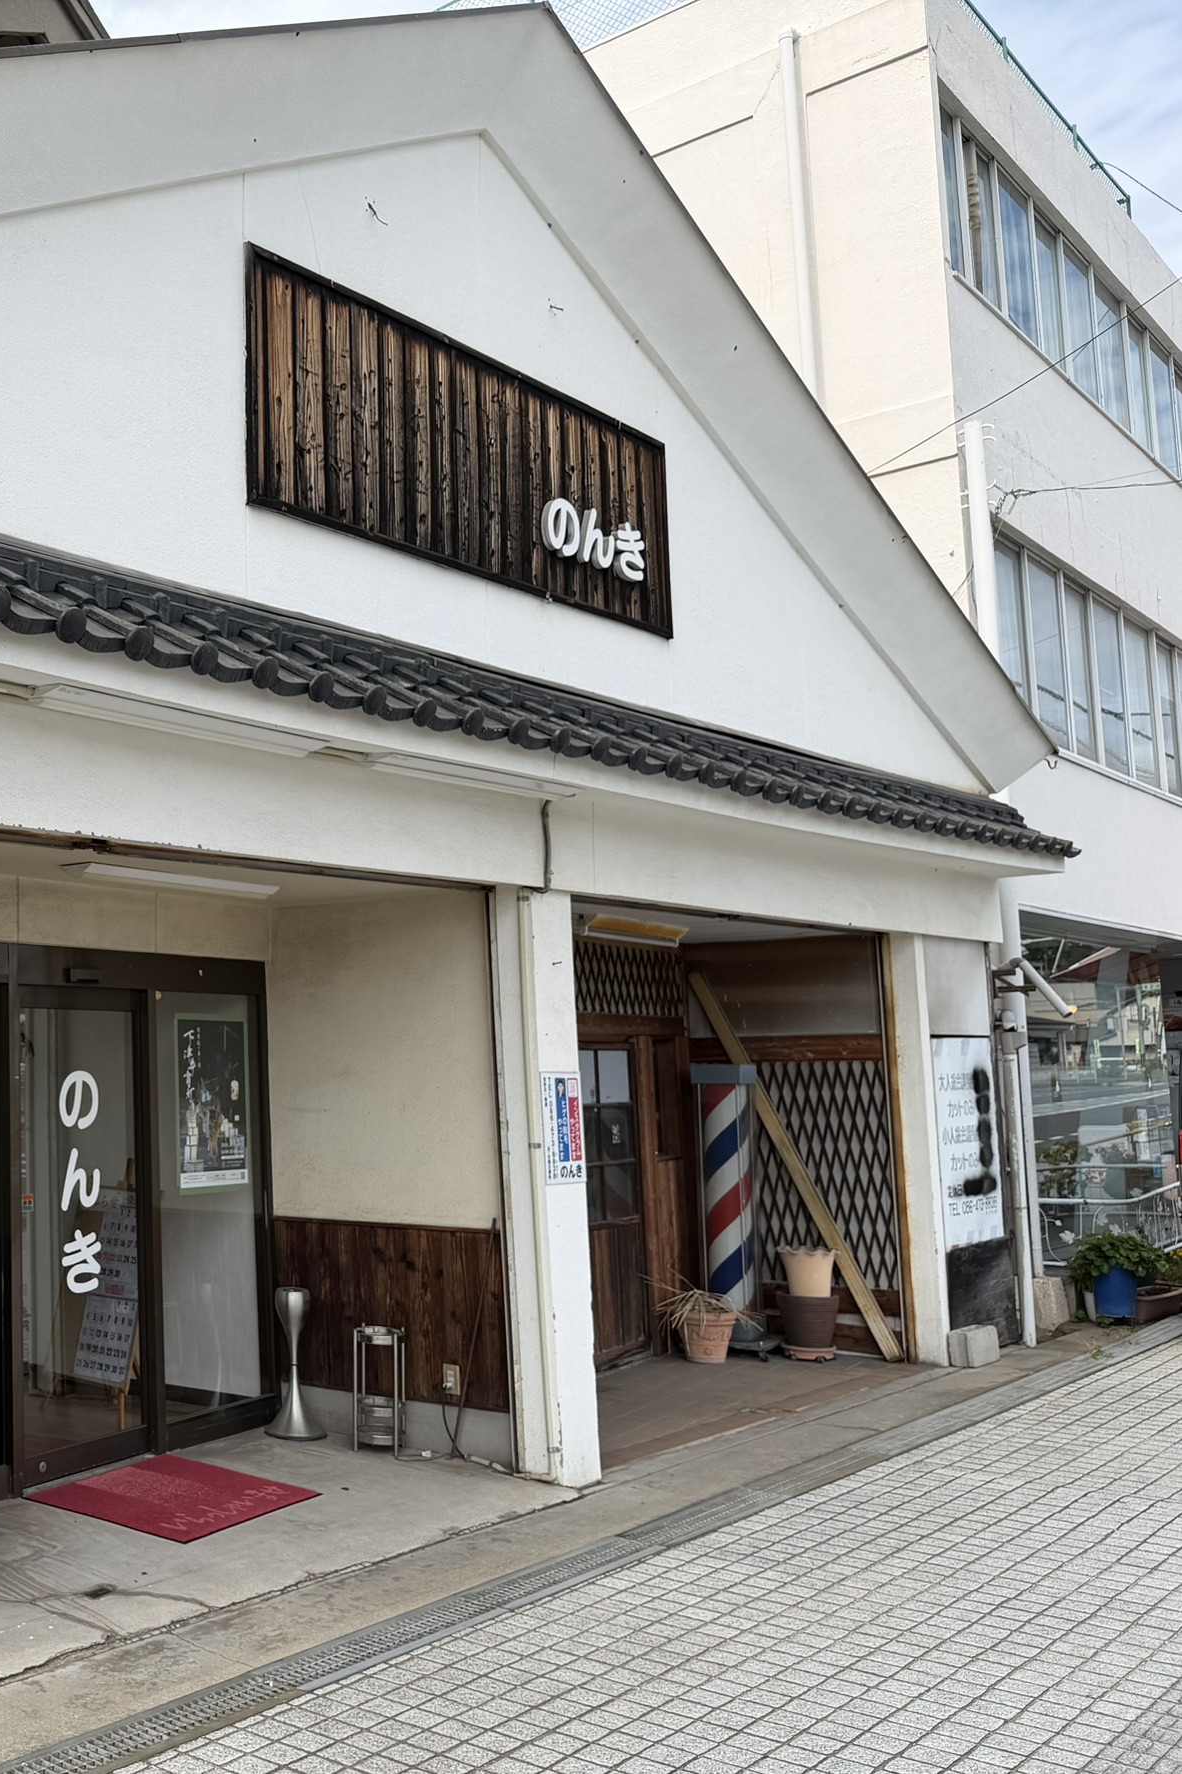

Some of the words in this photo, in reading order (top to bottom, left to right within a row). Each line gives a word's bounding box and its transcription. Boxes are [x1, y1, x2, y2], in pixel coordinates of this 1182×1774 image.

[541, 497, 645, 582] のんき
[58, 1069, 102, 1295] のんき
[560, 1163, 582, 1179] のんき
